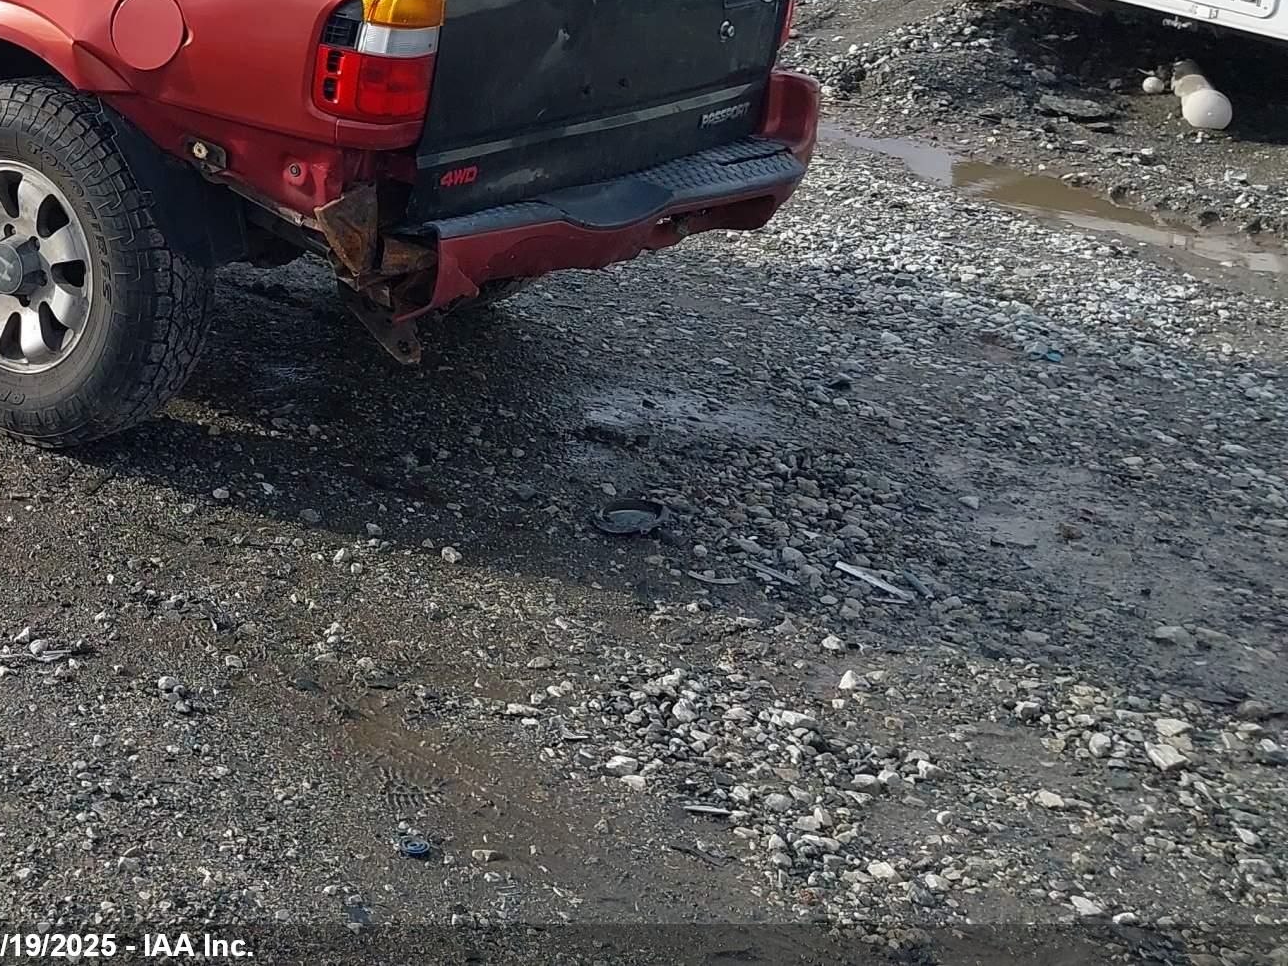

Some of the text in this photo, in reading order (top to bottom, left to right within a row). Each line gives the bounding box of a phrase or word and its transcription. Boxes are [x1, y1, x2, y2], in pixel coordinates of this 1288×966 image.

[700, 102, 750, 129] PASSPORT
[27, 141, 85, 198] TOYO
[440, 165, 478, 186] 4WD
